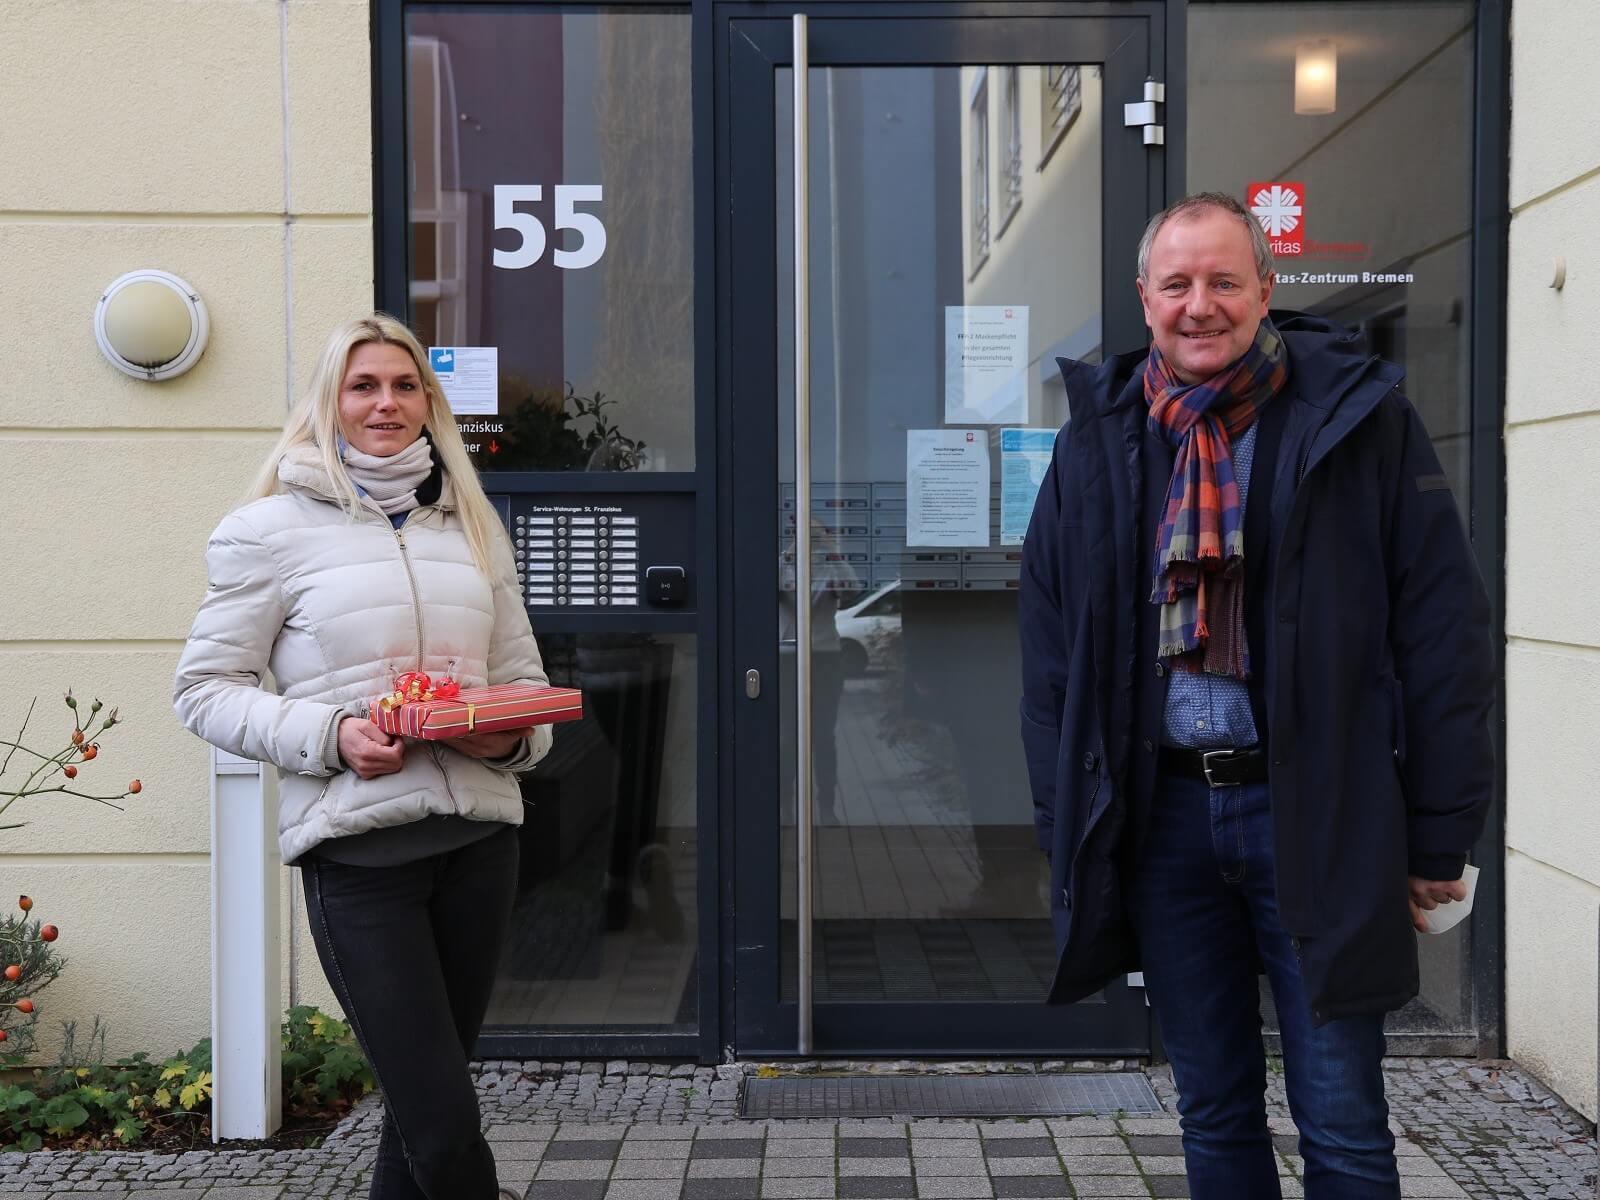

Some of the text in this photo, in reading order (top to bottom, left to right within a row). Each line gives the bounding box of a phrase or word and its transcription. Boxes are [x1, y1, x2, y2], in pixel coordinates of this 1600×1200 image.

[493, 184, 607, 270] 55
[1269, 240, 1301, 254] ritas
[1275, 271, 1414, 284] tas-Zentrum Bremen
[458, 421, 504, 433] anziskus
[464, 443, 481, 453] ner
